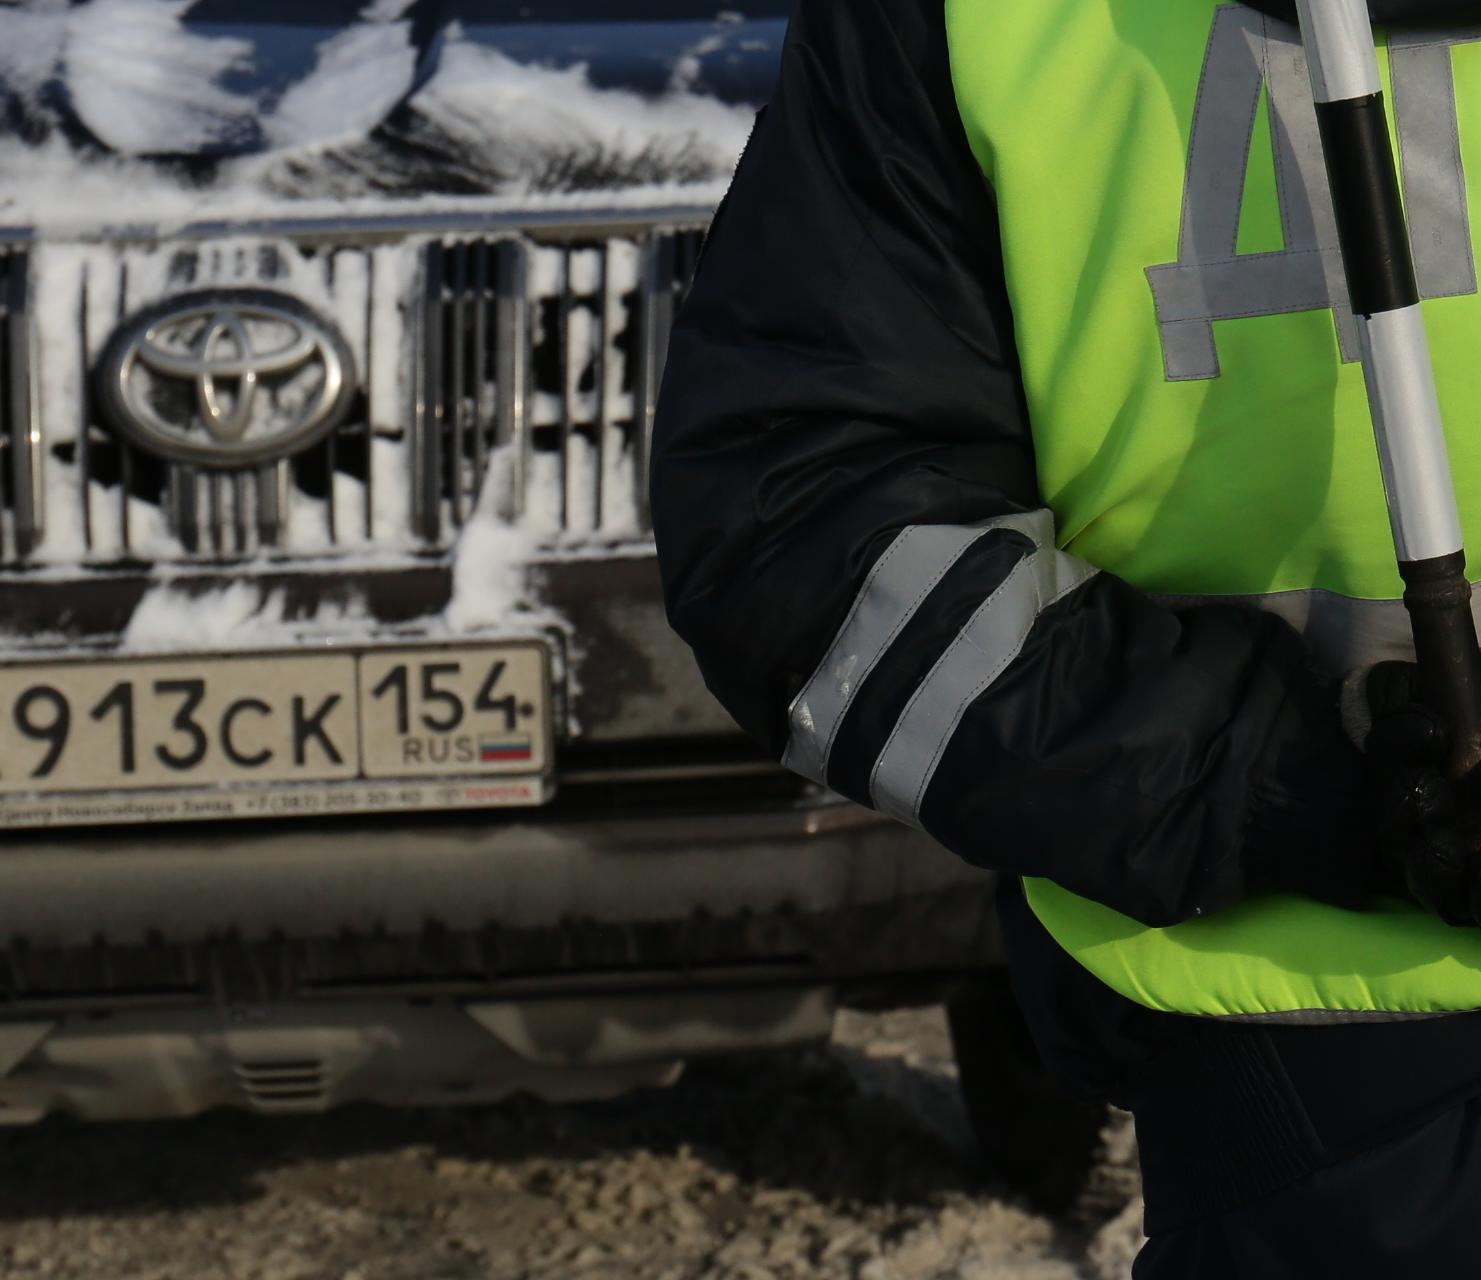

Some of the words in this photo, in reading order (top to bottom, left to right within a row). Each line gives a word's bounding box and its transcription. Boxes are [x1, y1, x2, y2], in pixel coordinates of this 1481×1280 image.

[0, 679, 343, 778] 913СК
[372, 659, 516, 735] 154
[402, 736, 475, 764] RUS
